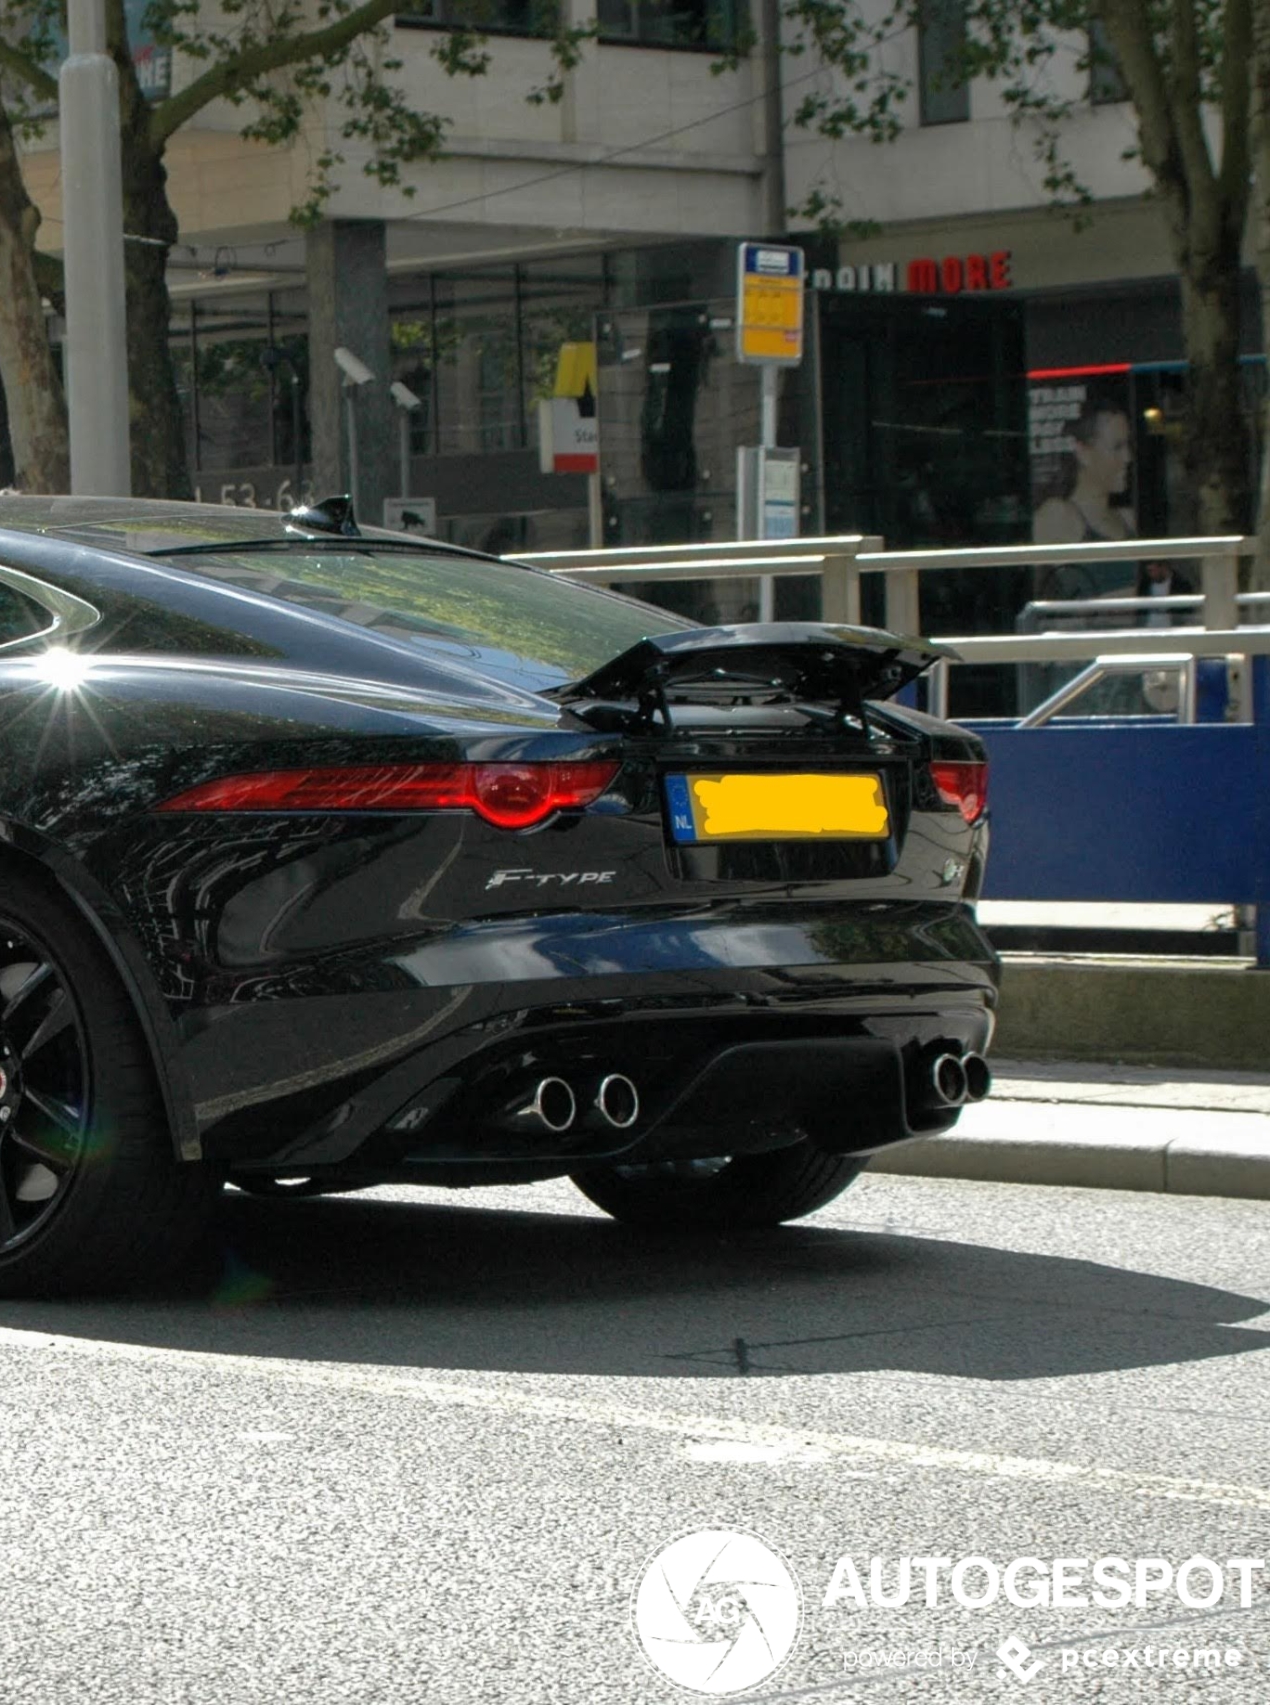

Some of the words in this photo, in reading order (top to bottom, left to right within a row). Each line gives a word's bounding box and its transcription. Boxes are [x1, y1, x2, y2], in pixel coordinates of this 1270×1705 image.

[803, 262, 894, 292] RAIN
[907, 250, 1011, 294] MORE
[674, 814, 692, 829] NL
[485, 869, 616, 890] F-TYPE
